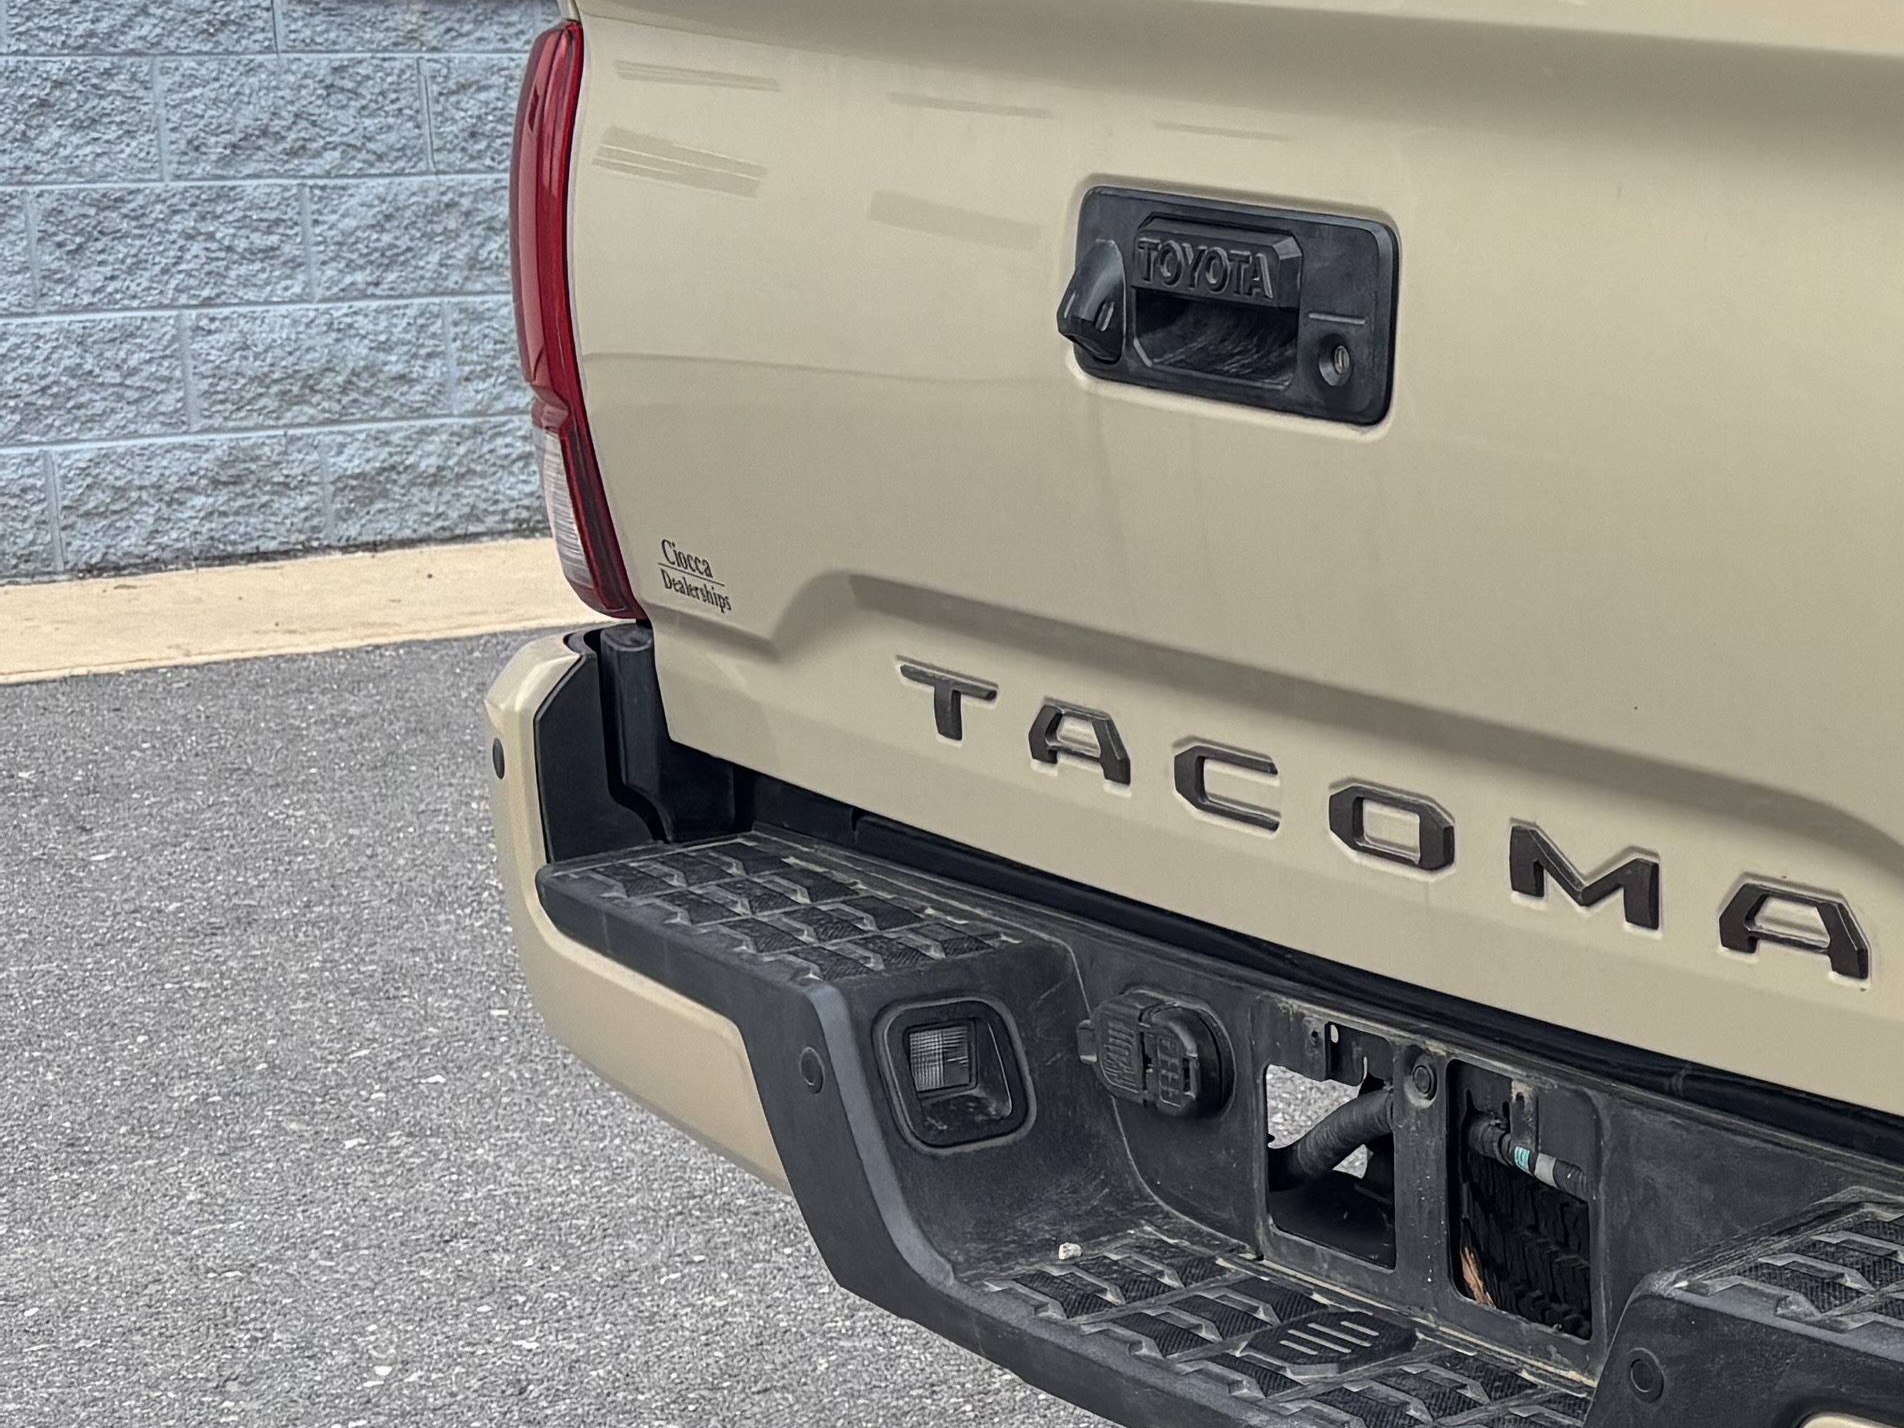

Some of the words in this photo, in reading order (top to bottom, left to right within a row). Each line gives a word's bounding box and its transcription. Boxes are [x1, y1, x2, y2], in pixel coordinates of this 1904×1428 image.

[1136, 236, 1274, 300] TOYOTA
[660, 538, 713, 578] Ciocca
[660, 568, 732, 613] Dealerships
[899, 660, 1871, 981] TACOMA
